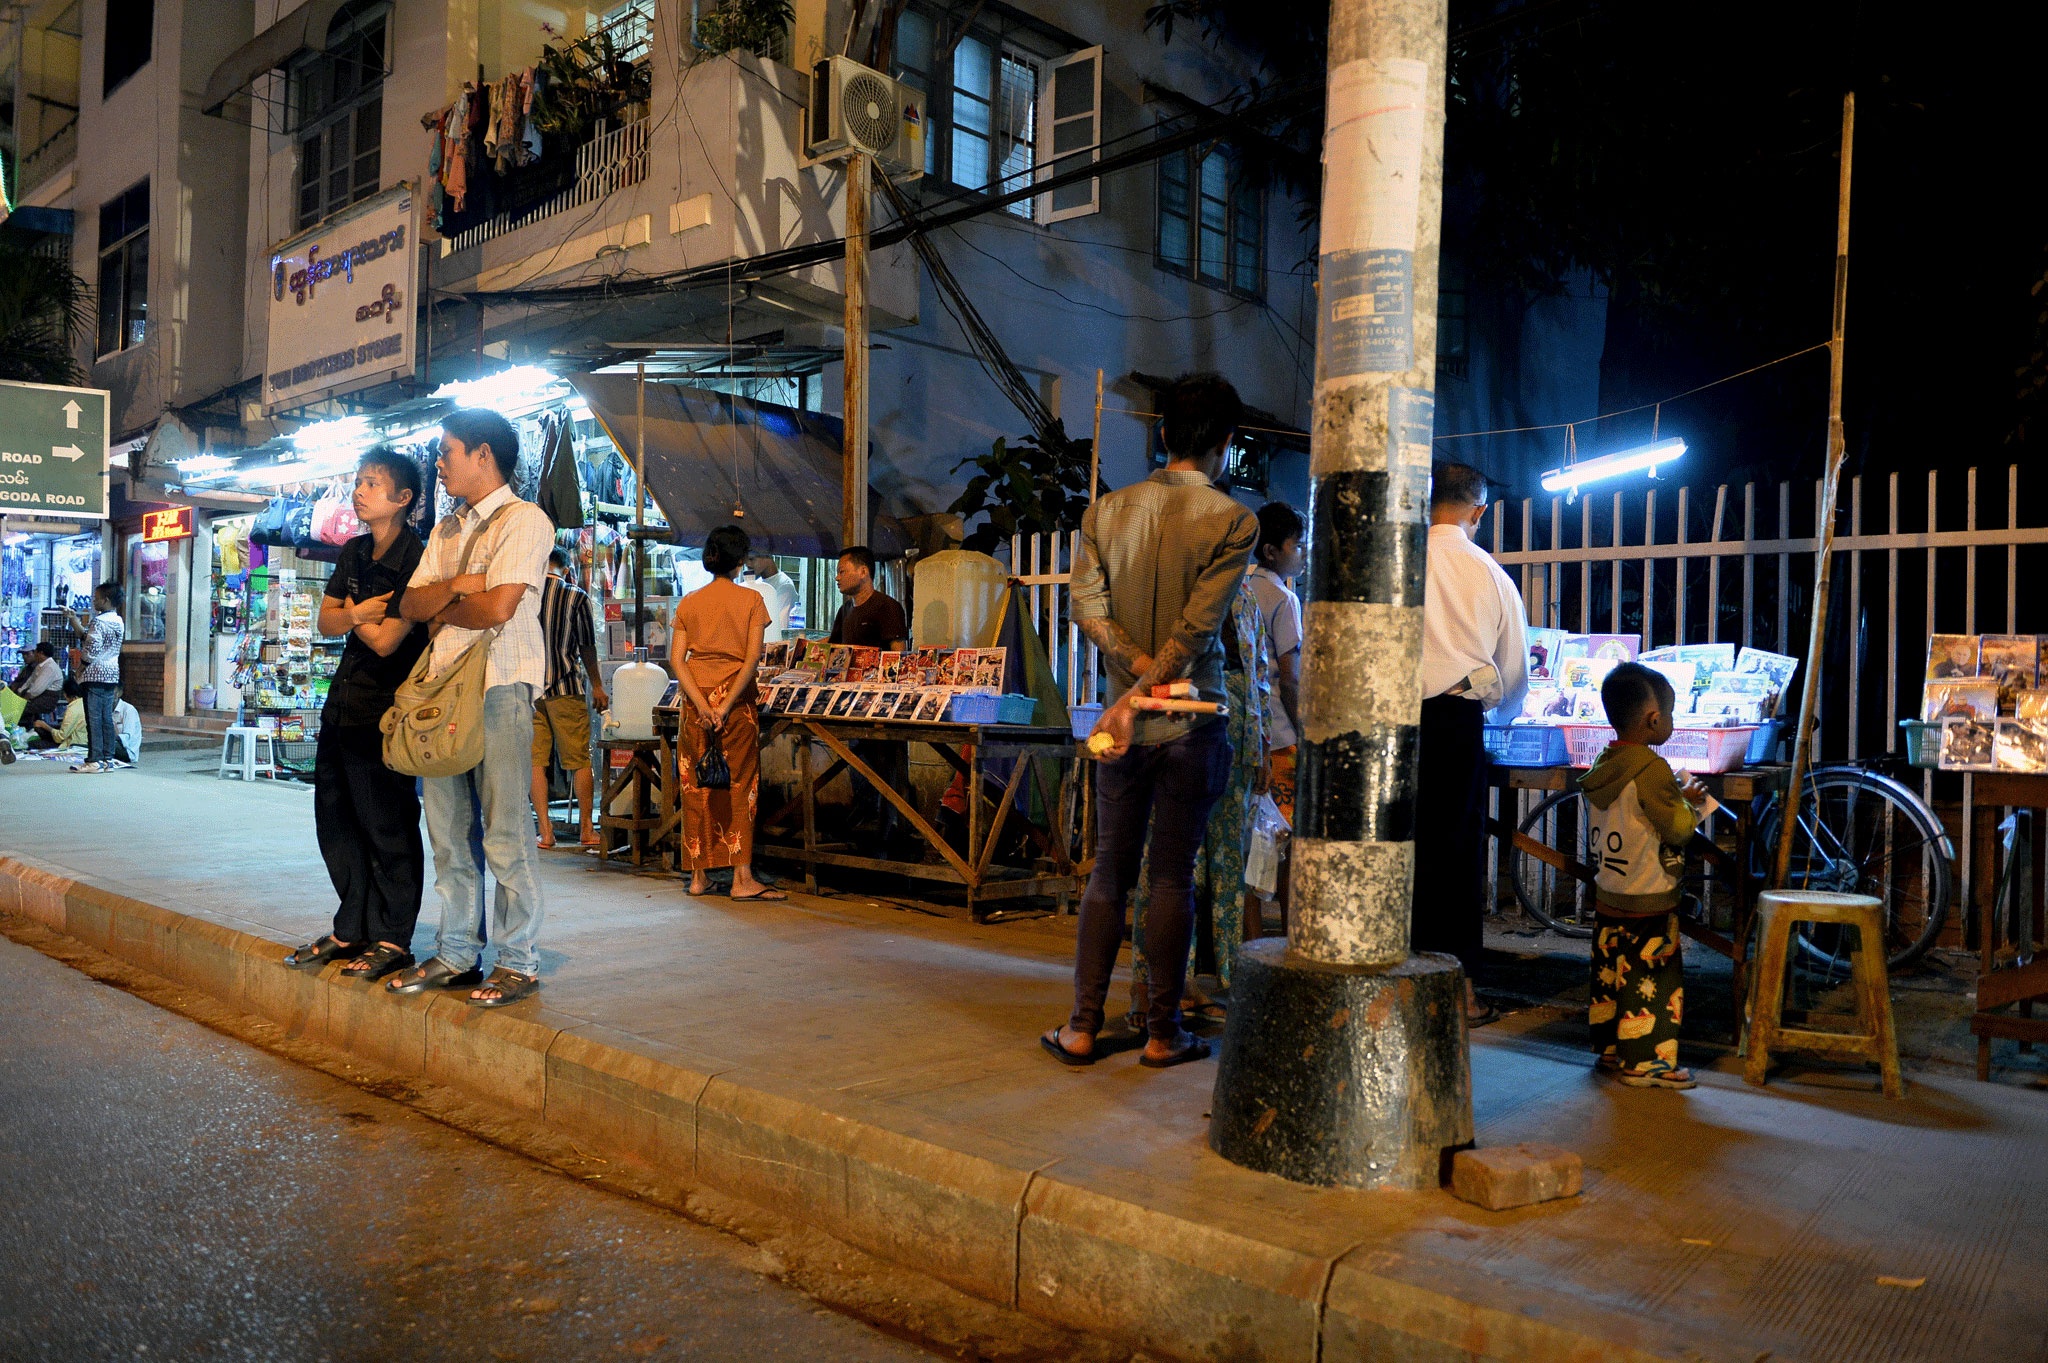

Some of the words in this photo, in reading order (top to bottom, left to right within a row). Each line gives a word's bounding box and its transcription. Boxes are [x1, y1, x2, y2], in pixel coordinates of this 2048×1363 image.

[357, 332, 402, 365] STORE
[1, 452, 43, 465] ROAD
[45, 493, 86, 506] ROAD
